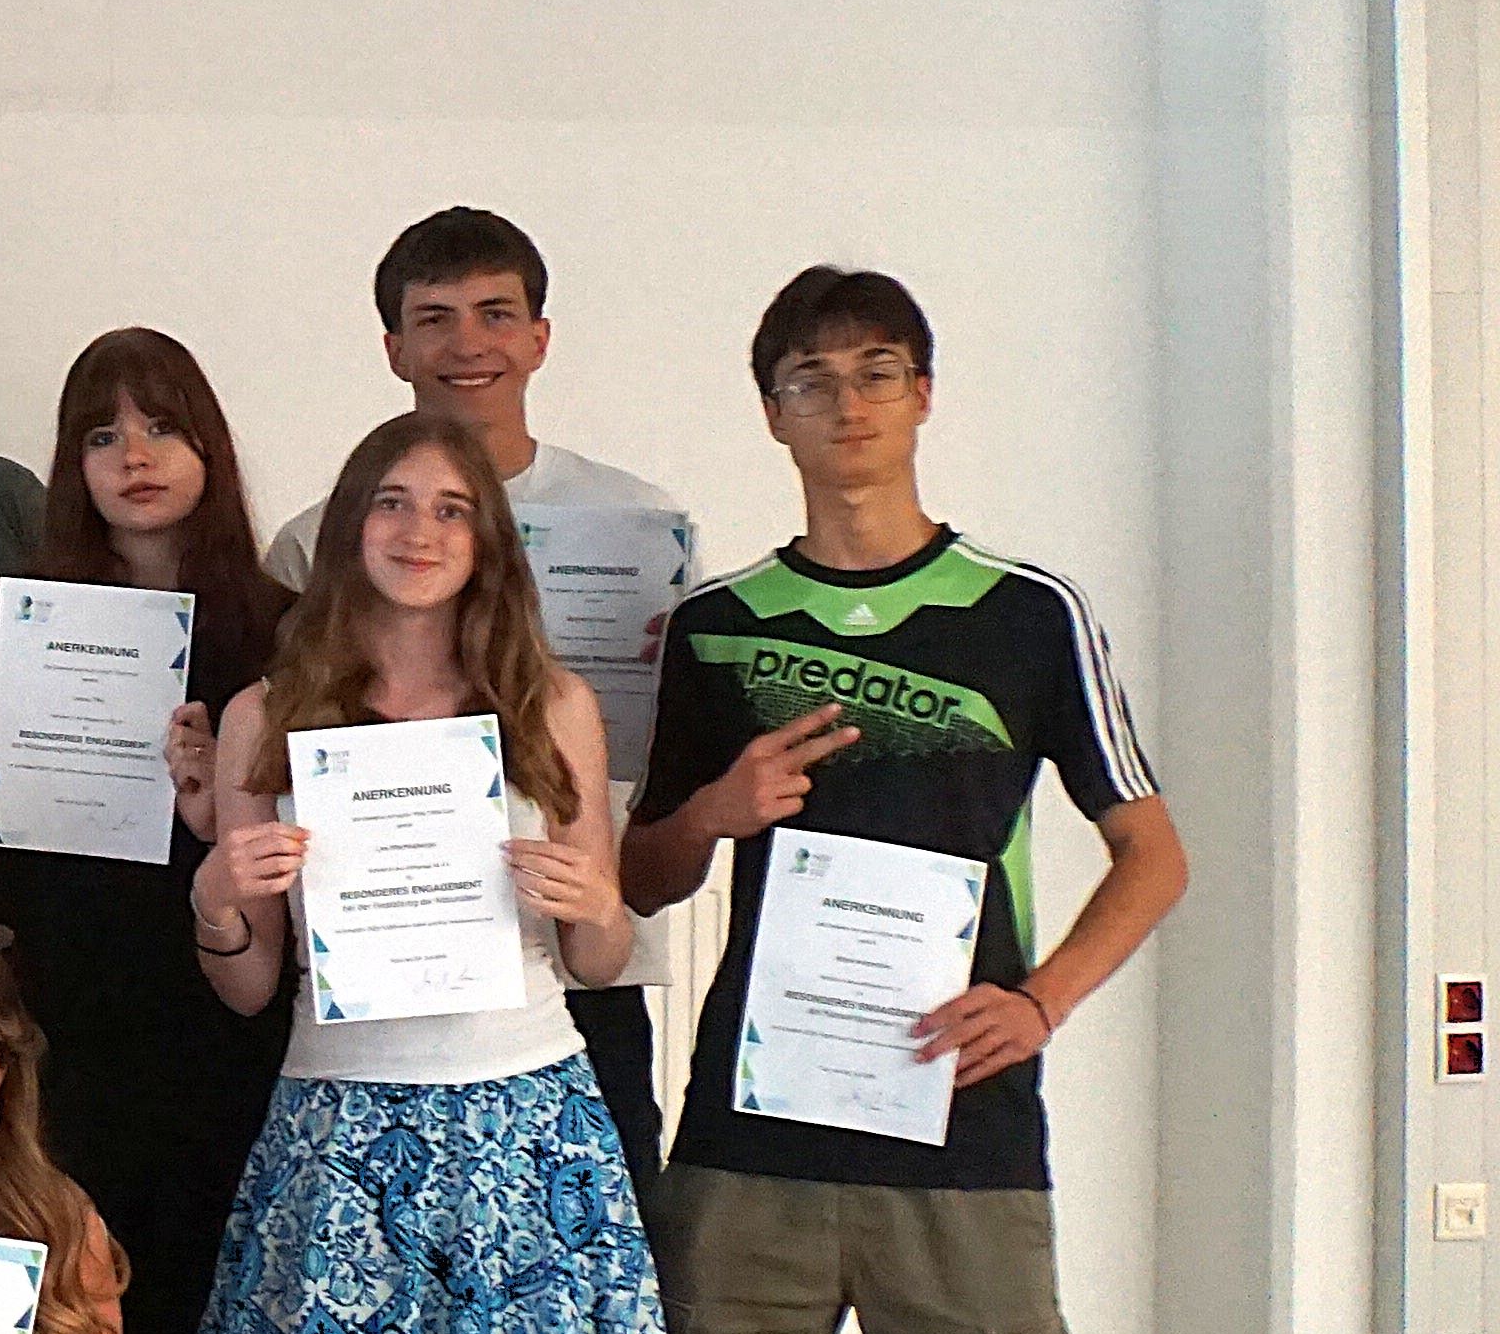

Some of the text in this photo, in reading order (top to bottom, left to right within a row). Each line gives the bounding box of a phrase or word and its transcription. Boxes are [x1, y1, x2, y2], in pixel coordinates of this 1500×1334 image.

[46, 641, 140, 659] ANERKENNUNG
[749, 649, 961, 725] predator
[352, 783, 452, 803] ANERKENNUNG
[822, 897, 925, 924] ANERKENNUNG
